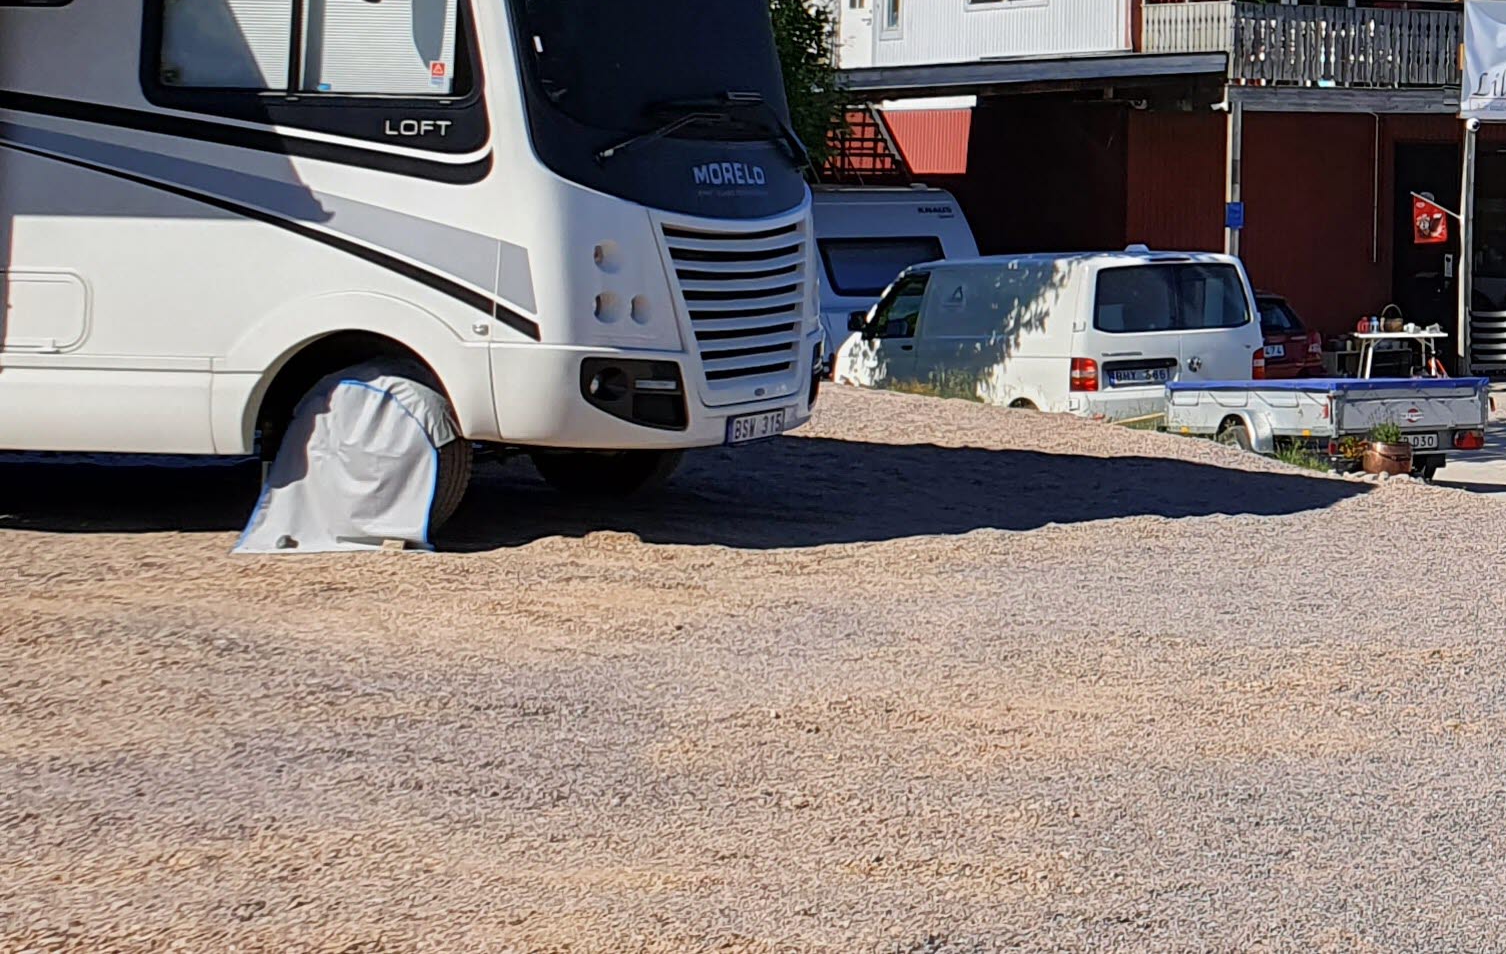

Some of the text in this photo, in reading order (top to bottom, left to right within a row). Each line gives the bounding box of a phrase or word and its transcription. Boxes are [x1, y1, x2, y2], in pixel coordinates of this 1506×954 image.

[385, 119, 452, 136] LOFT
[693, 162, 766, 185] MORELO
[762, 413, 782, 435] 315
